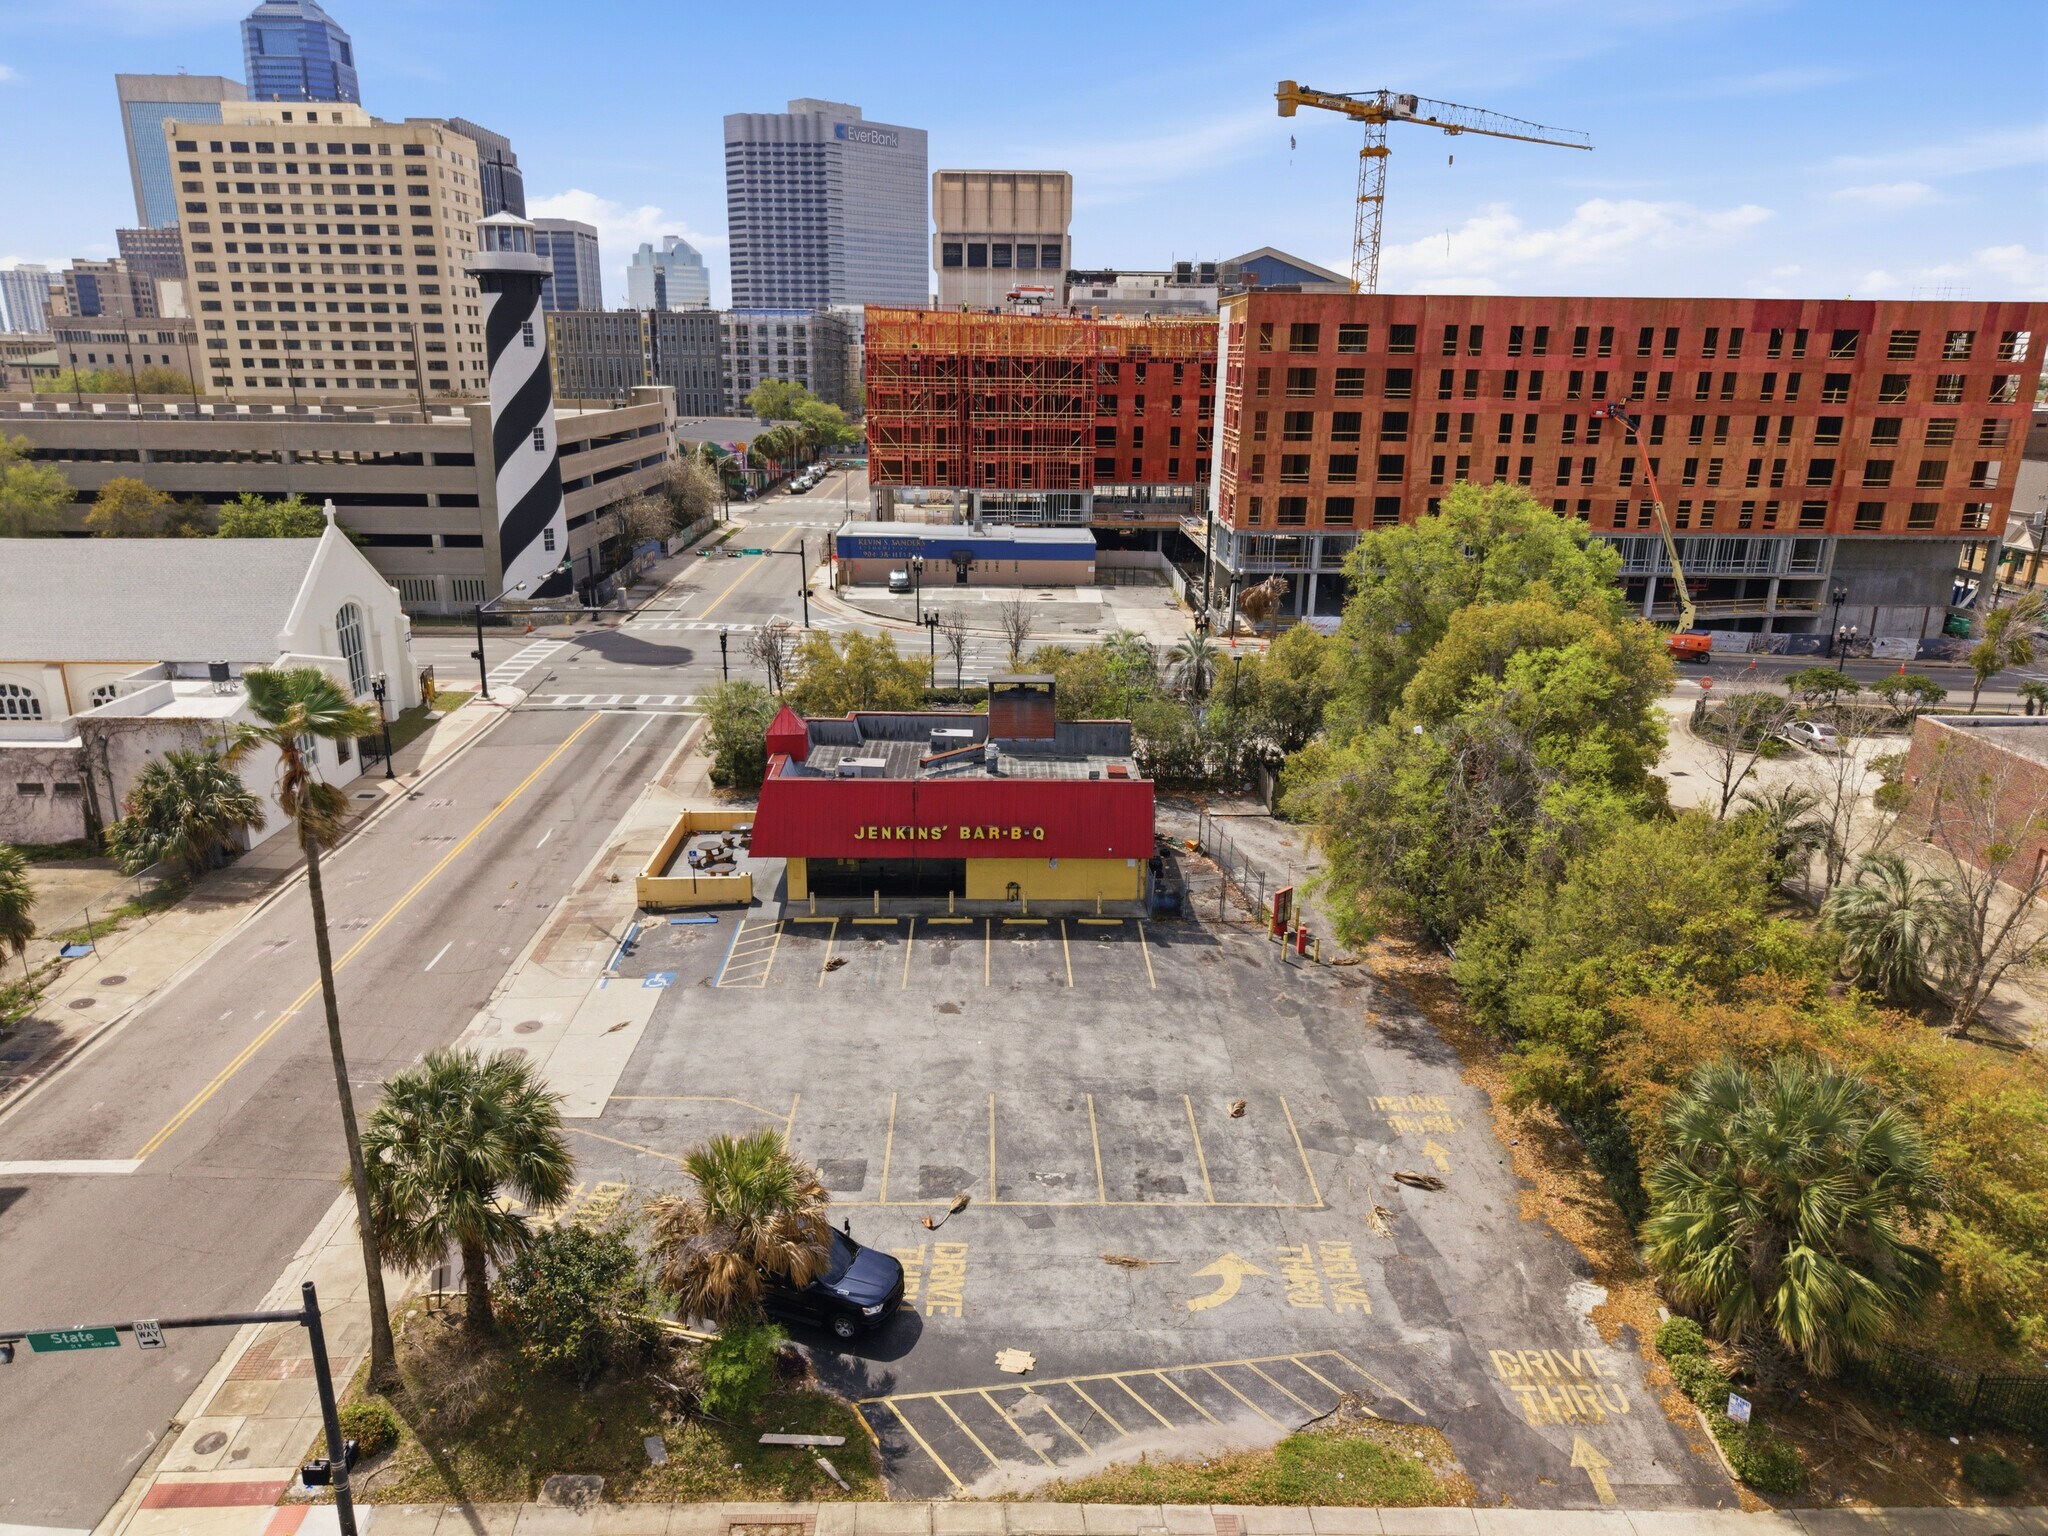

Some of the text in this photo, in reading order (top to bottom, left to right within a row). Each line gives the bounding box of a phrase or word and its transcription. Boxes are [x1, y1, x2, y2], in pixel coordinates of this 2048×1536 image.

[848, 126, 898, 147] EverBank
[926, 1242, 969, 1317] DRIVE
[1318, 1241, 1372, 1315] DRIVE
[50, 1332, 94, 1344] State
[136, 1323, 157, 1331] ONE
[1489, 1349, 1618, 1377] DRIVE
[1510, 1383, 1630, 1415] THRU
